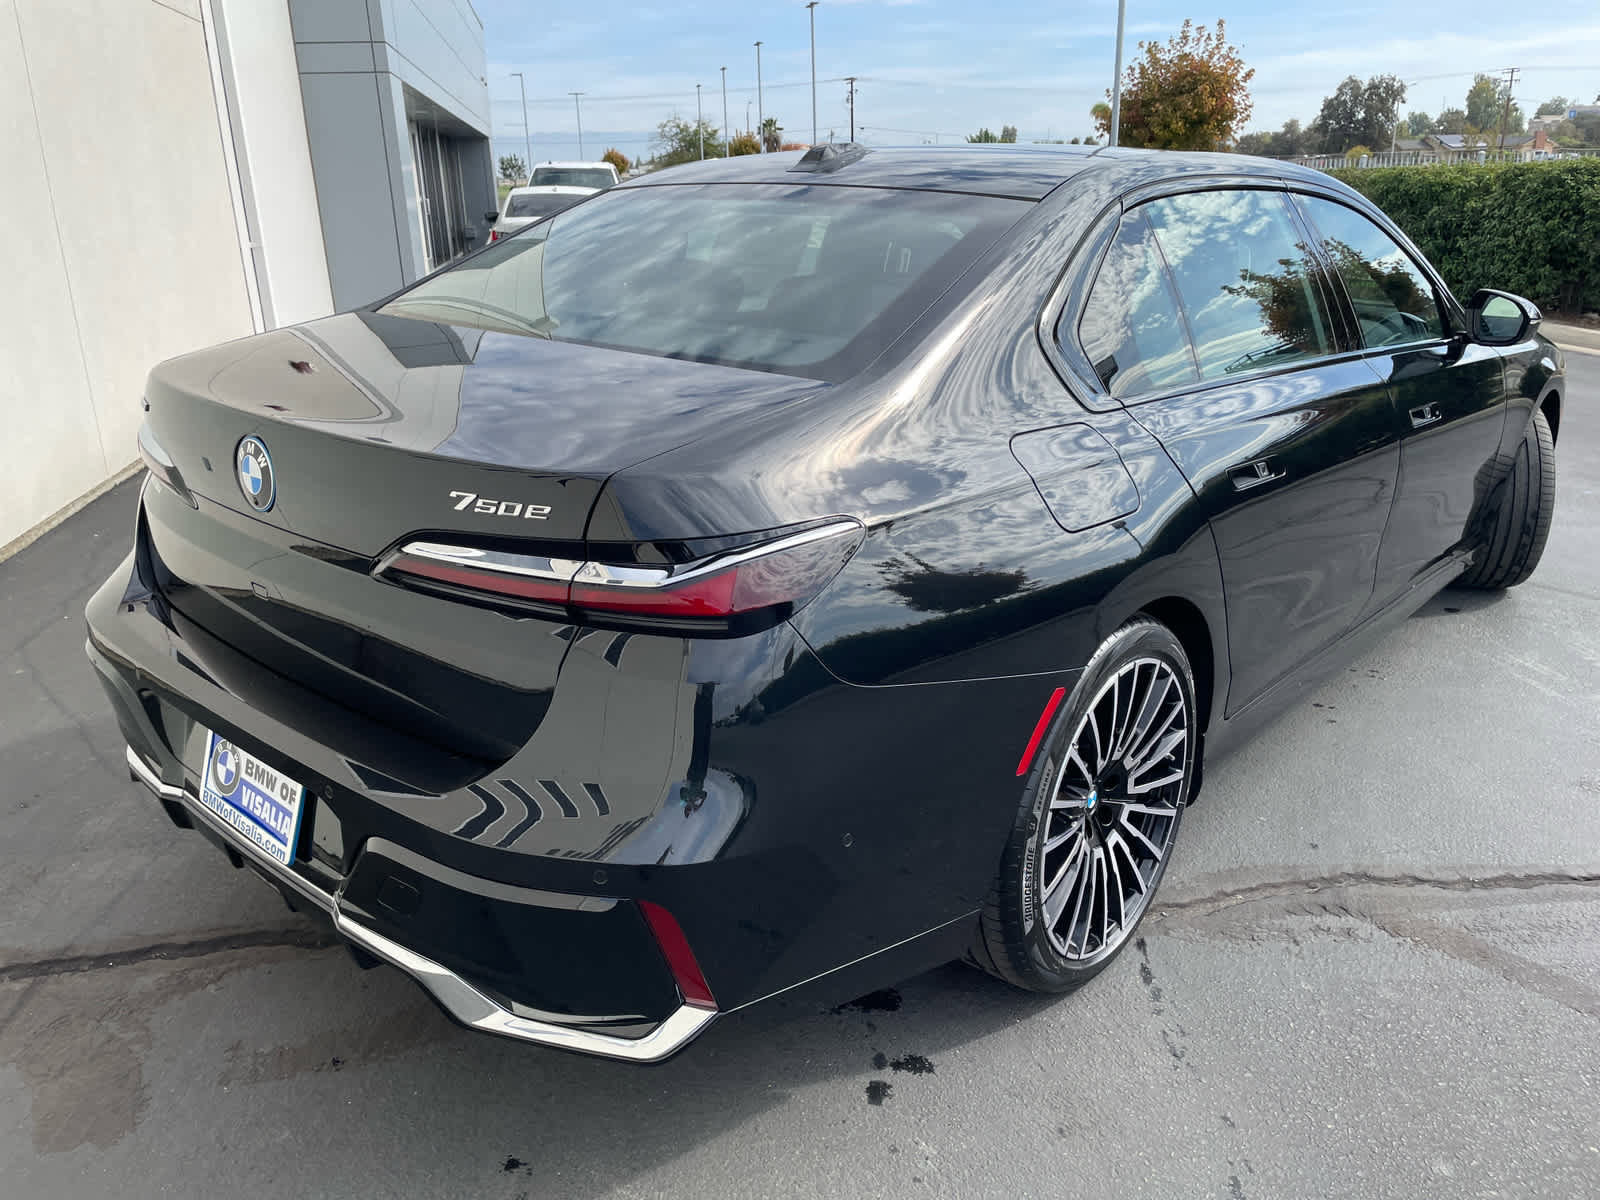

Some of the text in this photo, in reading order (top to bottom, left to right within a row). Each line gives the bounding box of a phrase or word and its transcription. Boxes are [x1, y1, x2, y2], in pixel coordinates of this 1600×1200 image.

[239, 441, 267, 468] BMW
[449, 491, 552, 519] 750e
[245, 758, 298, 806] BMW OF
[202, 790, 286, 862] BMWofVisalia.com
[242, 784, 292, 837] VISALIA
[1024, 847, 1036, 923] BRIDGESTONE
